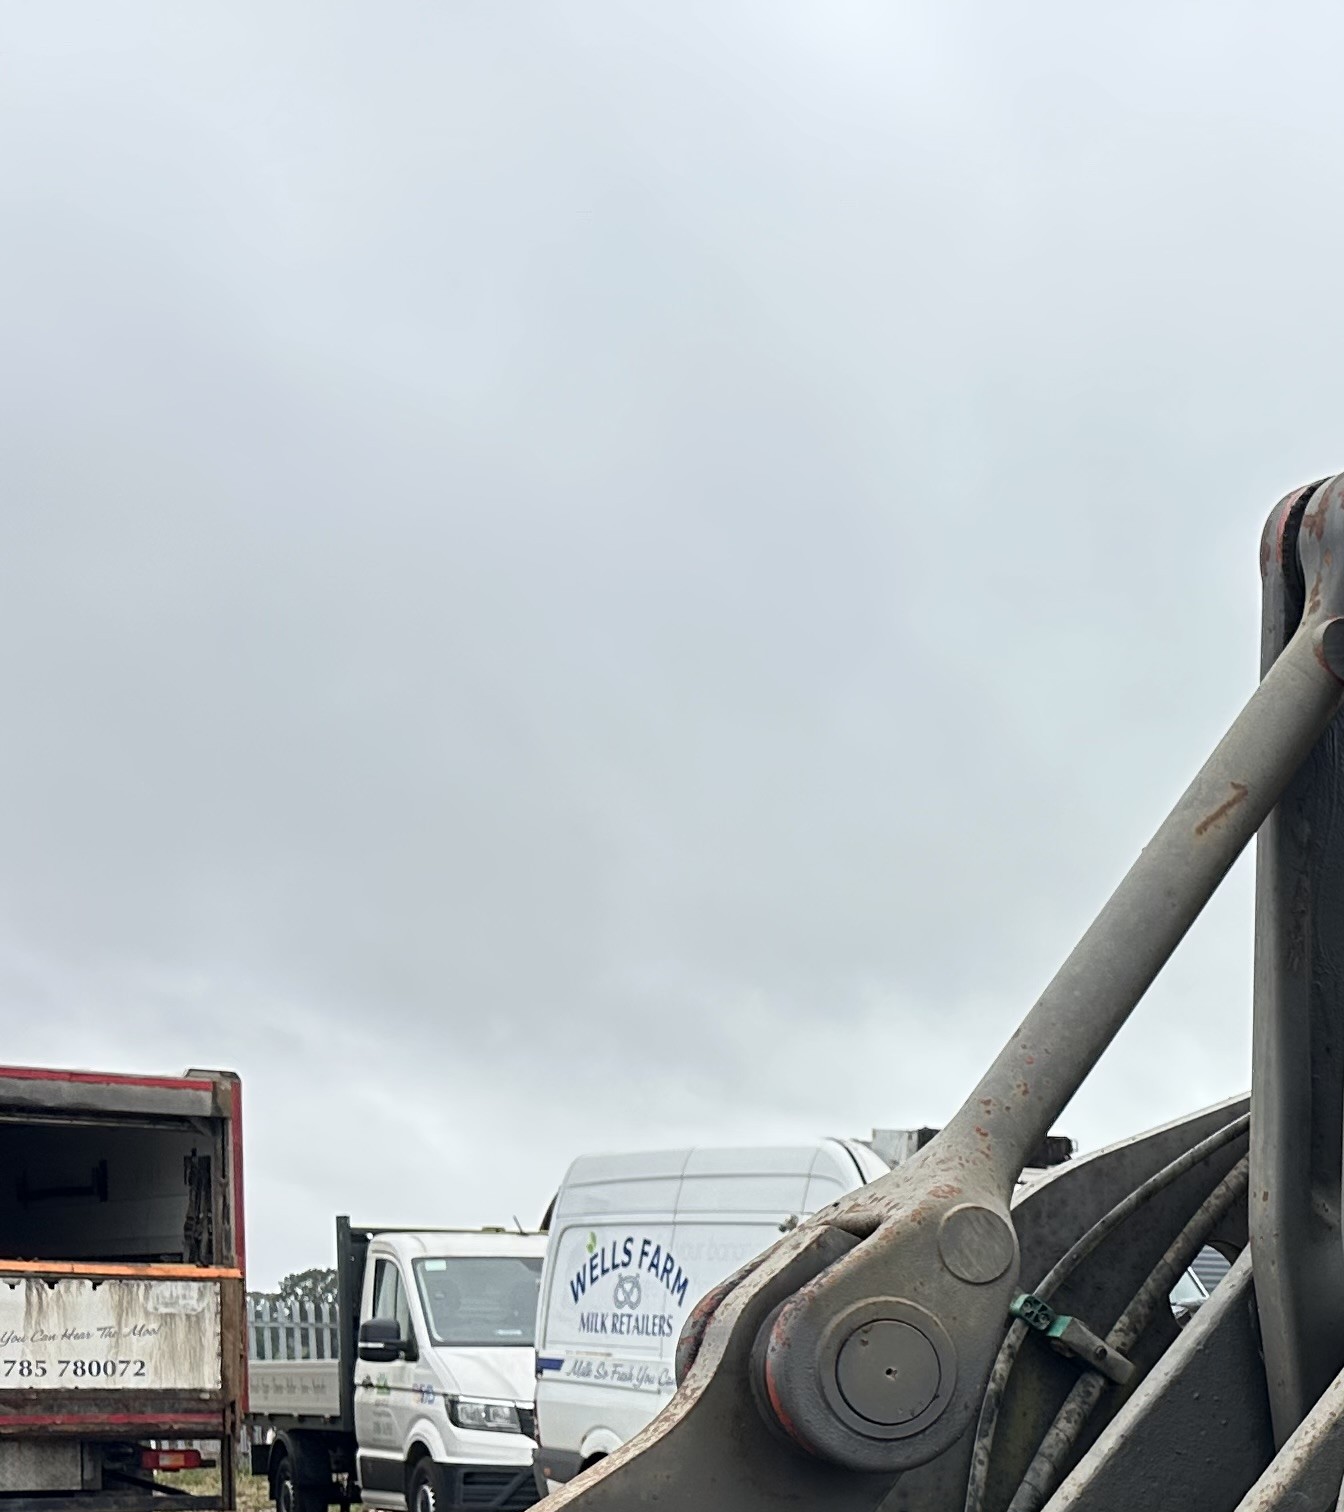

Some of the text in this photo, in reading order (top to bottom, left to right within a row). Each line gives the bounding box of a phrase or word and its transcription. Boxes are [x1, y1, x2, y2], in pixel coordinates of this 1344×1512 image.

[570, 1236, 689, 1308] WELLS FARM
[30, 1328, 56, 1343] Can
[578, 1312, 673, 1338] MILK RETAILERS
[58, 1360, 146, 1378] 780072
